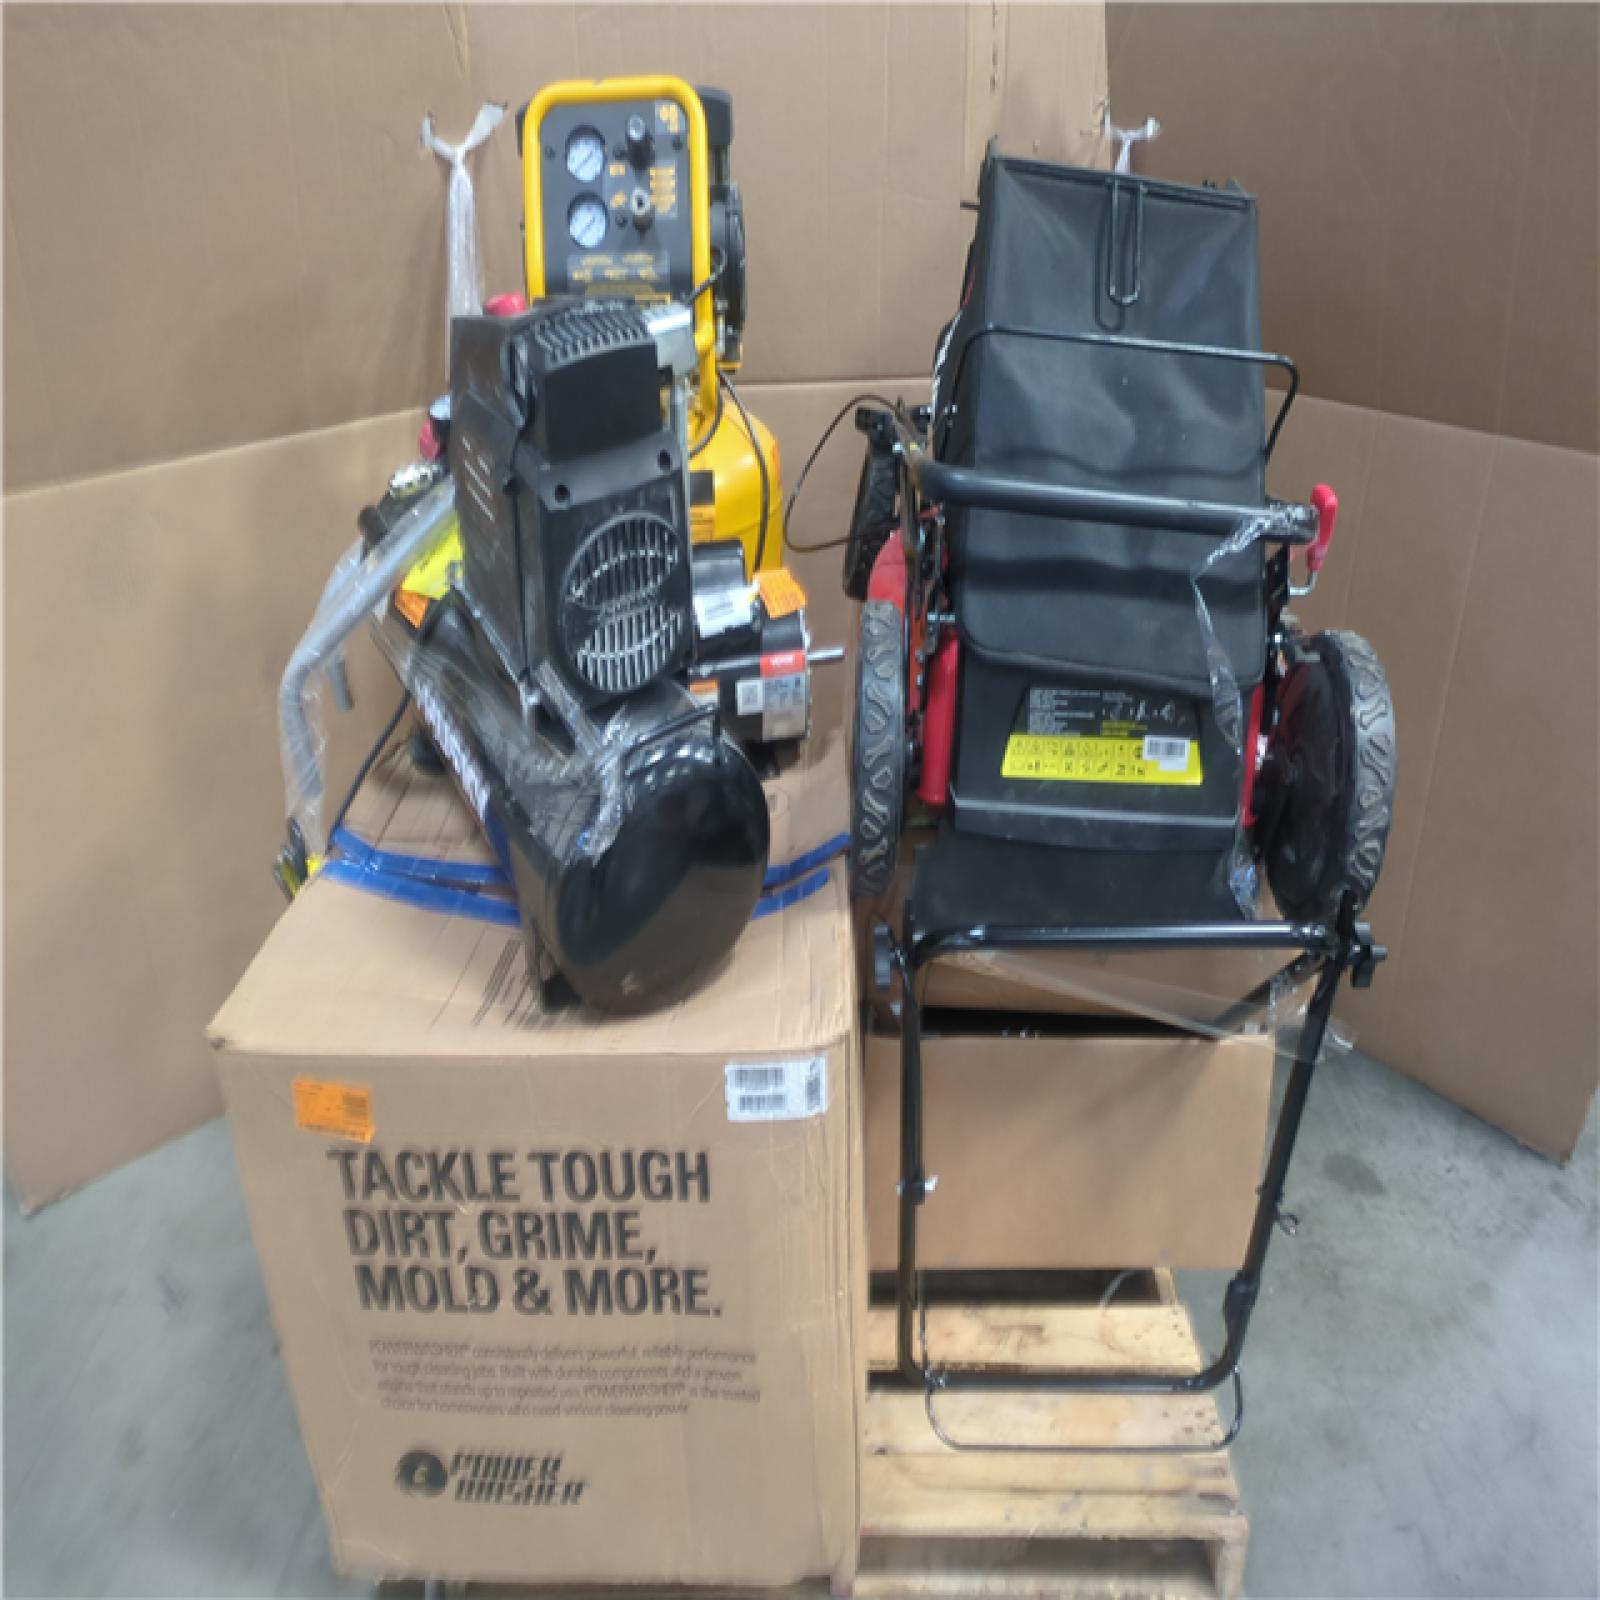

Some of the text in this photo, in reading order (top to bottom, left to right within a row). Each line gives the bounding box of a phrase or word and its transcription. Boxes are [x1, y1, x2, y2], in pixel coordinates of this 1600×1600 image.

[327, 1150, 709, 1203] TACKLE TOUGH
[343, 1208, 656, 1265] DIRT, GRIME,
[354, 1265, 721, 1316] MOLD & MORE.
[452, 1454, 562, 1481] POWER
[455, 1479, 585, 1505] WASHER
